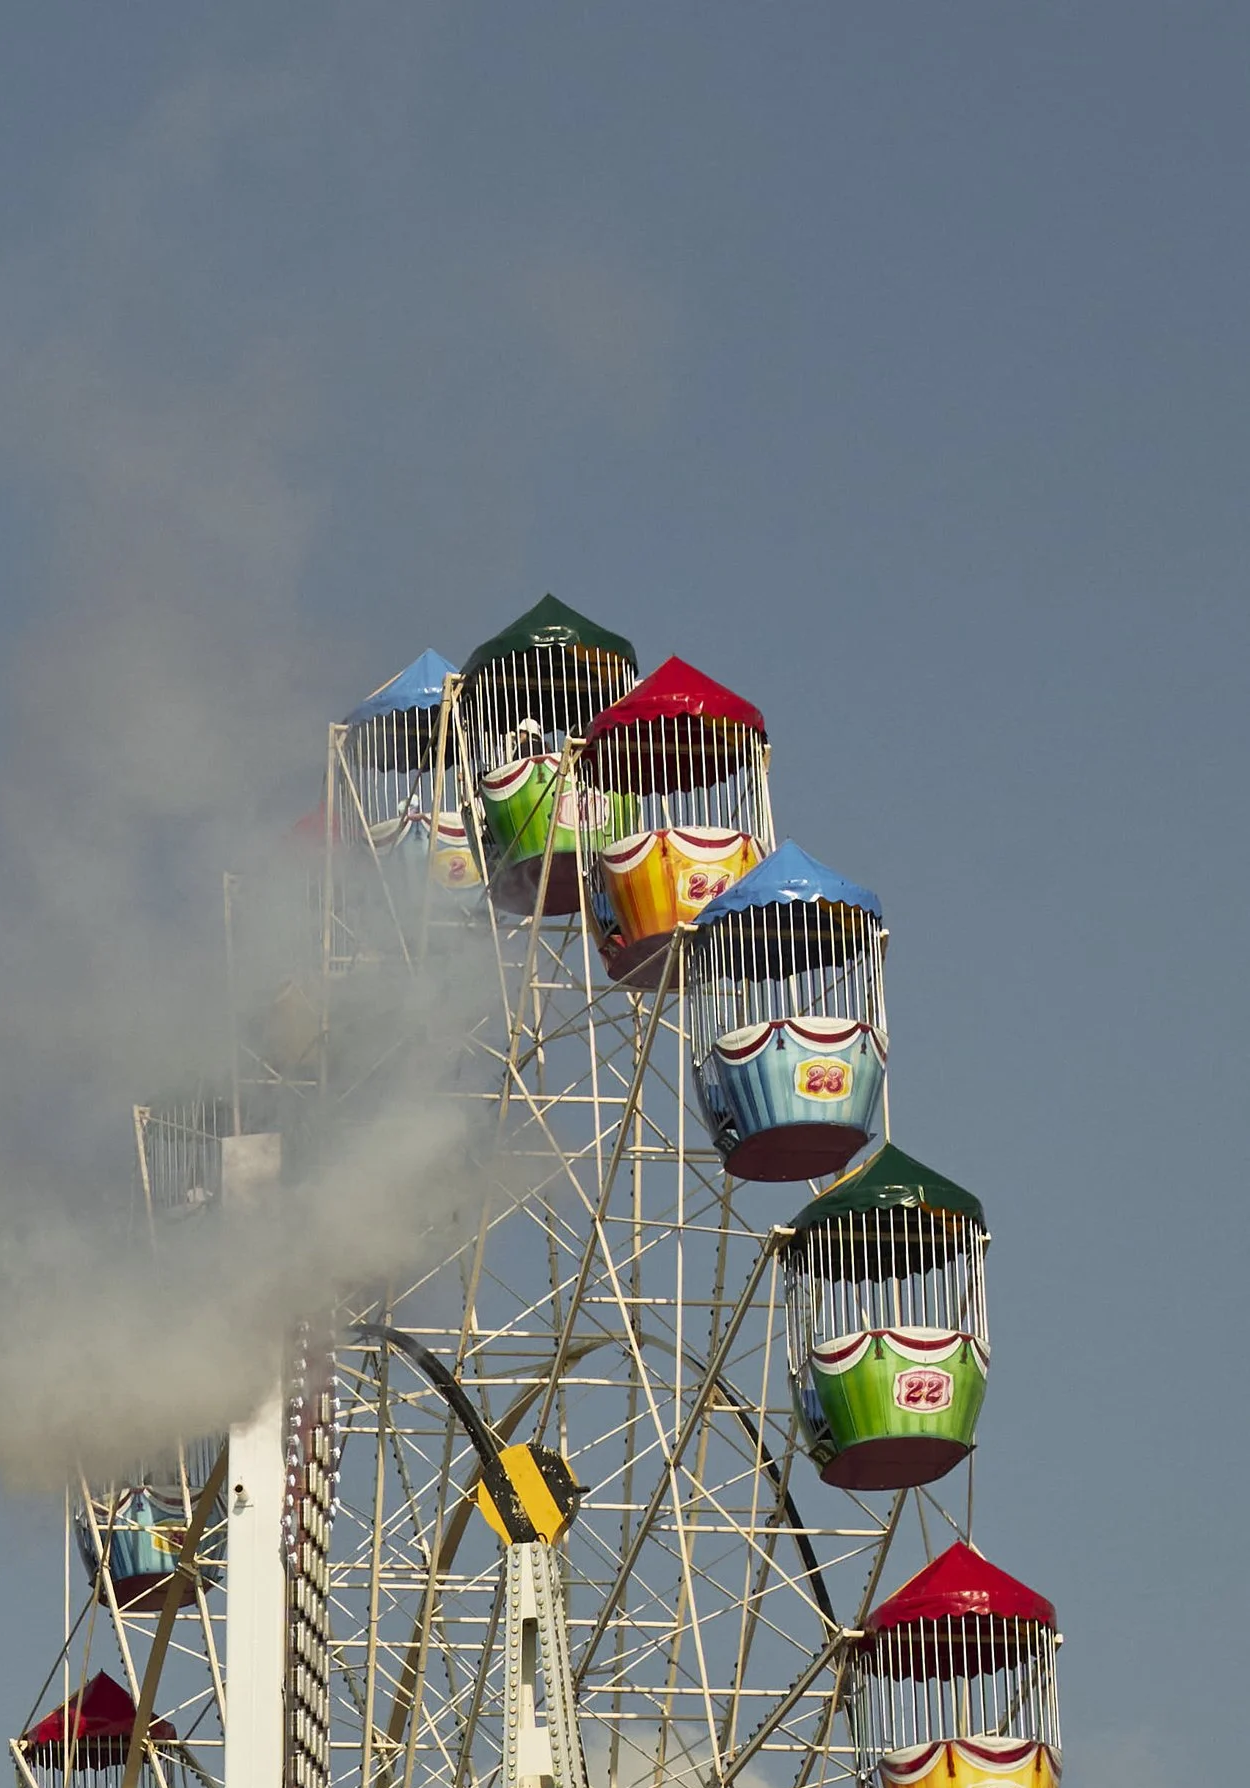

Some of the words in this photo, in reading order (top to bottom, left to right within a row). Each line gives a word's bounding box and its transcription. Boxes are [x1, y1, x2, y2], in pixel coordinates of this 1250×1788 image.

[688, 872, 730, 901] 24
[806, 1065, 845, 1094] 23
[905, 1376, 944, 1405] 22
